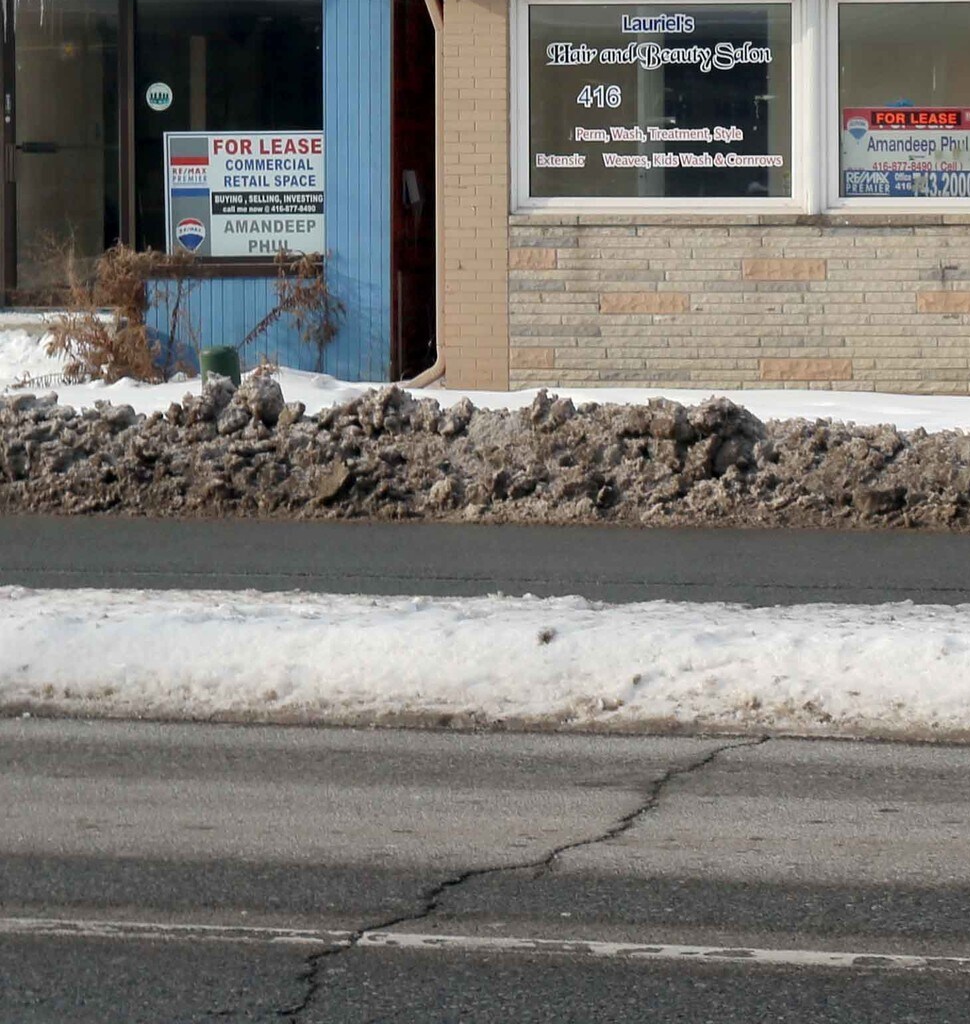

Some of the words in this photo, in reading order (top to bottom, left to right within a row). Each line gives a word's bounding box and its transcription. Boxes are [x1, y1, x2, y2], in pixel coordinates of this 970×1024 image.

[621, 14, 695, 33] Lauriel's
[546, 42, 597, 66] Hair
[600, 42, 638, 64] and
[636, 42, 712, 72] Beauty
[712, 41, 773, 70] Salon
[577, 85, 622, 108] 416
[876, 113, 906, 125] FOR
[910, 113, 957, 124] LEASE
[575, 127, 610, 143] Perm,
[610, 126, 647, 143] Wash,
[647, 127, 712, 143] Treatment,
[714, 126, 744, 143] Style
[213, 139, 253, 156] FOR
[259, 138, 322, 155] LEASE
[867, 136, 937, 155] Amandeep
[225, 159, 314, 171] COMMERCIAL
[603, 153, 651, 169] Weaves,
[652, 152, 679, 168] Kids
[679, 152, 712, 167] Wash
[714, 153, 726, 167] &
[726, 153, 784, 167] Cornrows
[172, 167, 207, 175] RE/MAX
[846, 172, 889, 184] RE/MAX
[224, 176, 270, 188] RETAIL
[274, 175, 316, 187] SPACE
[846, 184, 890, 194] PREMIER
[248, 194, 282, 205] SELLING,
[283, 194, 323, 204] INVESTING
[222, 205, 236, 213] call
[224, 220, 316, 234] AMANDEEP
[248, 239, 293, 253] PHUL
